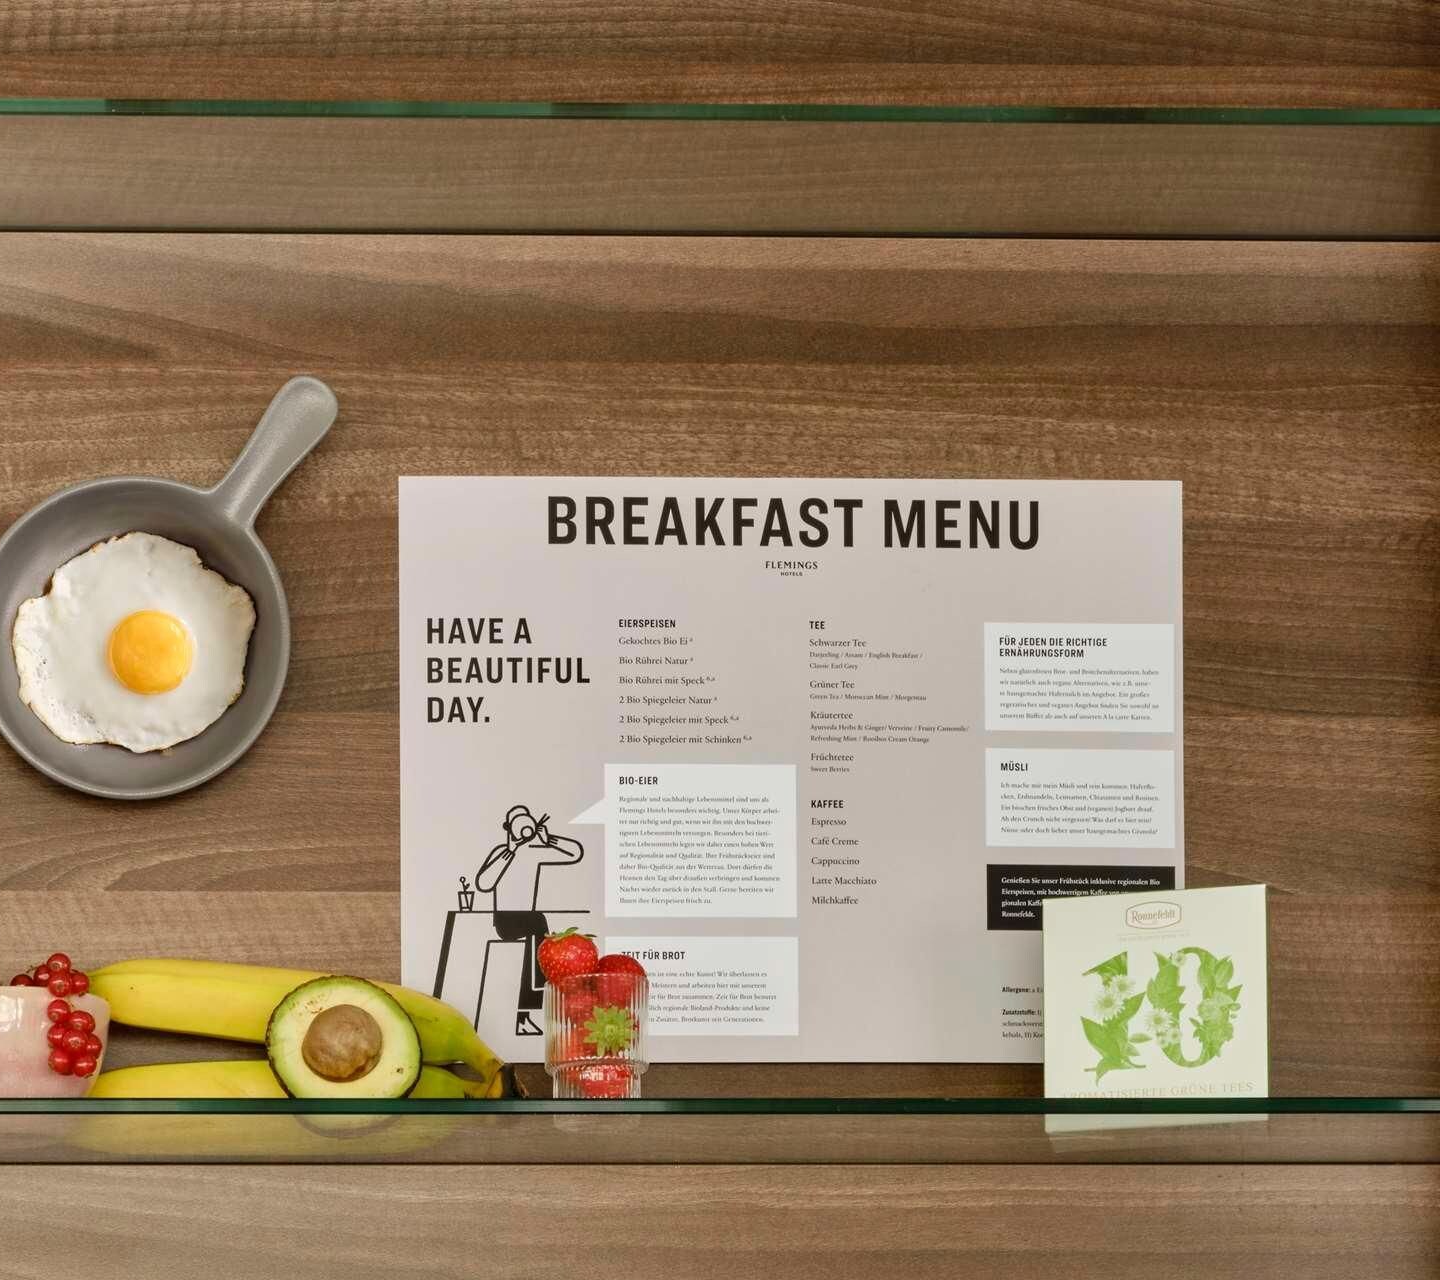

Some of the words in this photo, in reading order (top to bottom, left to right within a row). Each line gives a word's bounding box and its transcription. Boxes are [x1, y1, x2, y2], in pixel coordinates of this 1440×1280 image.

[547, 495, 863, 548] BREAKFAST
[883, 499, 1039, 550] MENU
[765, 560, 818, 572] FLEMINGS
[618, 617, 676, 628] EIERSPEISEN
[808, 620, 825, 630] TEE
[426, 617, 503, 644] HAVE
[513, 617, 532, 644] A
[618, 636, 661, 647] Gekochtes
[663, 637, 677, 645] Bio
[679, 636, 688, 645] Ei
[809, 638, 851, 648] Schwarzer
[851, 638, 866, 647] Tee
[999, 635, 1016, 646] FÜR
[1019, 637, 1046, 647] JEDEN
[1049, 637, 1063, 646] DIE
[1065, 637, 1107, 647] RICHTIGE
[999, 647, 1084, 658] ERNÄHRUNGSFORM
[618, 655, 634, 664] Bio
[635, 656, 662, 664] Rührei
[664, 655, 688, 665] Natur
[426, 656, 590, 684] BEAUTIFUL
[619, 675, 633, 684] Bio
[635, 675, 662, 684] Rührei
[680, 676, 705, 687] Speck
[809, 679, 839, 688] Grüner
[840, 680, 855, 689] Tee
[619, 696, 624, 704] 2
[627, 695, 640, 703] Bio
[642, 695, 686, 706] Spiegeleier
[688, 695, 712, 704] Natur
[427, 696, 490, 723] DAY.
[810, 711, 853, 719] Kräutertee
[619, 715, 624, 723] 2
[626, 714, 641, 723] Bio
[642, 714, 687, 727] Spiegeleier
[704, 715, 728, 725] Speck
[619, 735, 624, 743] 2
[627, 735, 640, 743] Bio
[642, 735, 687, 746] Spiegeleier
[704, 735, 741, 744] Schinken
[810, 752, 854, 761] Früchtetee
[1000, 760, 1028, 771] MÜSLI
[619, 775, 658, 785] BIO-EIER
[810, 799, 844, 808] KAFFEE
[811, 817, 847, 828] Espresso
[811, 837, 830, 845] Café
[831, 837, 859, 846] Creme
[810, 856, 860, 868] Cappuccino
[811, 876, 834, 886] Latte
[835, 876, 877, 885] Macchiato
[1149, 878, 1160, 886] Bio
[811, 895, 858, 904] Milchkaffee
[1131, 909, 1176, 922] Ronnefeldt
[642, 949, 660, 960] FÜR
[662, 951, 685, 960] BROT
[1001, 986, 1031, 994] Allergene:
[1002, 1008, 1037, 1016] Zusatzstoffe:
[1081, 947, 1243, 1072] 10
[1171, 1083, 1217, 1097] GRÜNE
[1222, 1081, 1254, 1093] TEES
